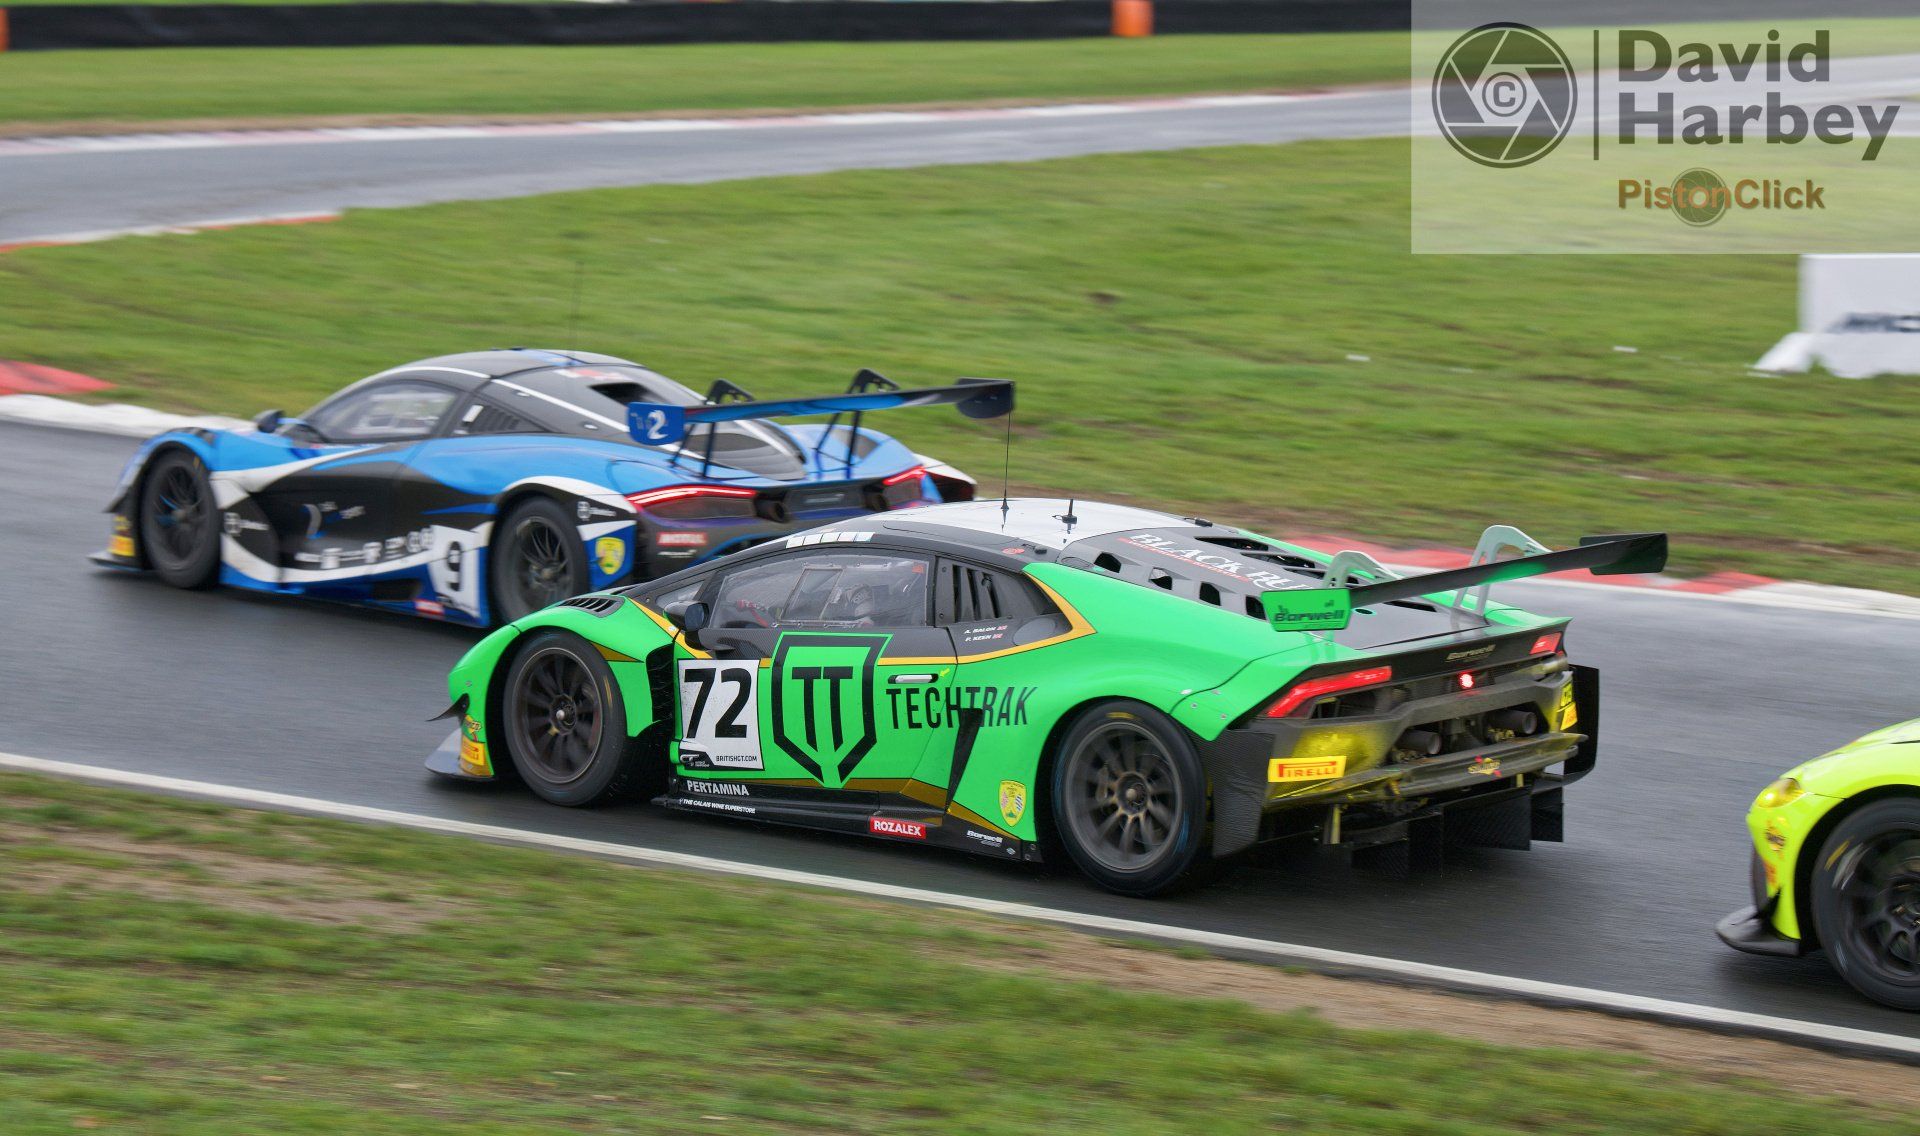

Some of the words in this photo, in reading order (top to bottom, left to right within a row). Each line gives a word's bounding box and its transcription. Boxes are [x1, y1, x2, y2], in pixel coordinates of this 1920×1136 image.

[647, 410, 668, 439] 2
[1130, 533, 1245, 574] BLACK
[448, 541, 461, 591] 9
[1274, 610, 1345, 622] Barwell
[684, 668, 752, 738] 72
[792, 666, 853, 752] TT
[886, 687, 1038, 729] TECHTRAK
[716, 755, 758, 763] BRITISHGT.COM
[1278, 761, 1337, 777] PIRELLI
[686, 780, 750, 796] PERTAMINA
[683, 798, 693, 806] THE
[693, 800, 711, 808] CALAIS
[711, 802, 725, 810] WINE
[725, 804, 756, 814] SUPERSTORE
[874, 820, 921, 836] ROZALEX
